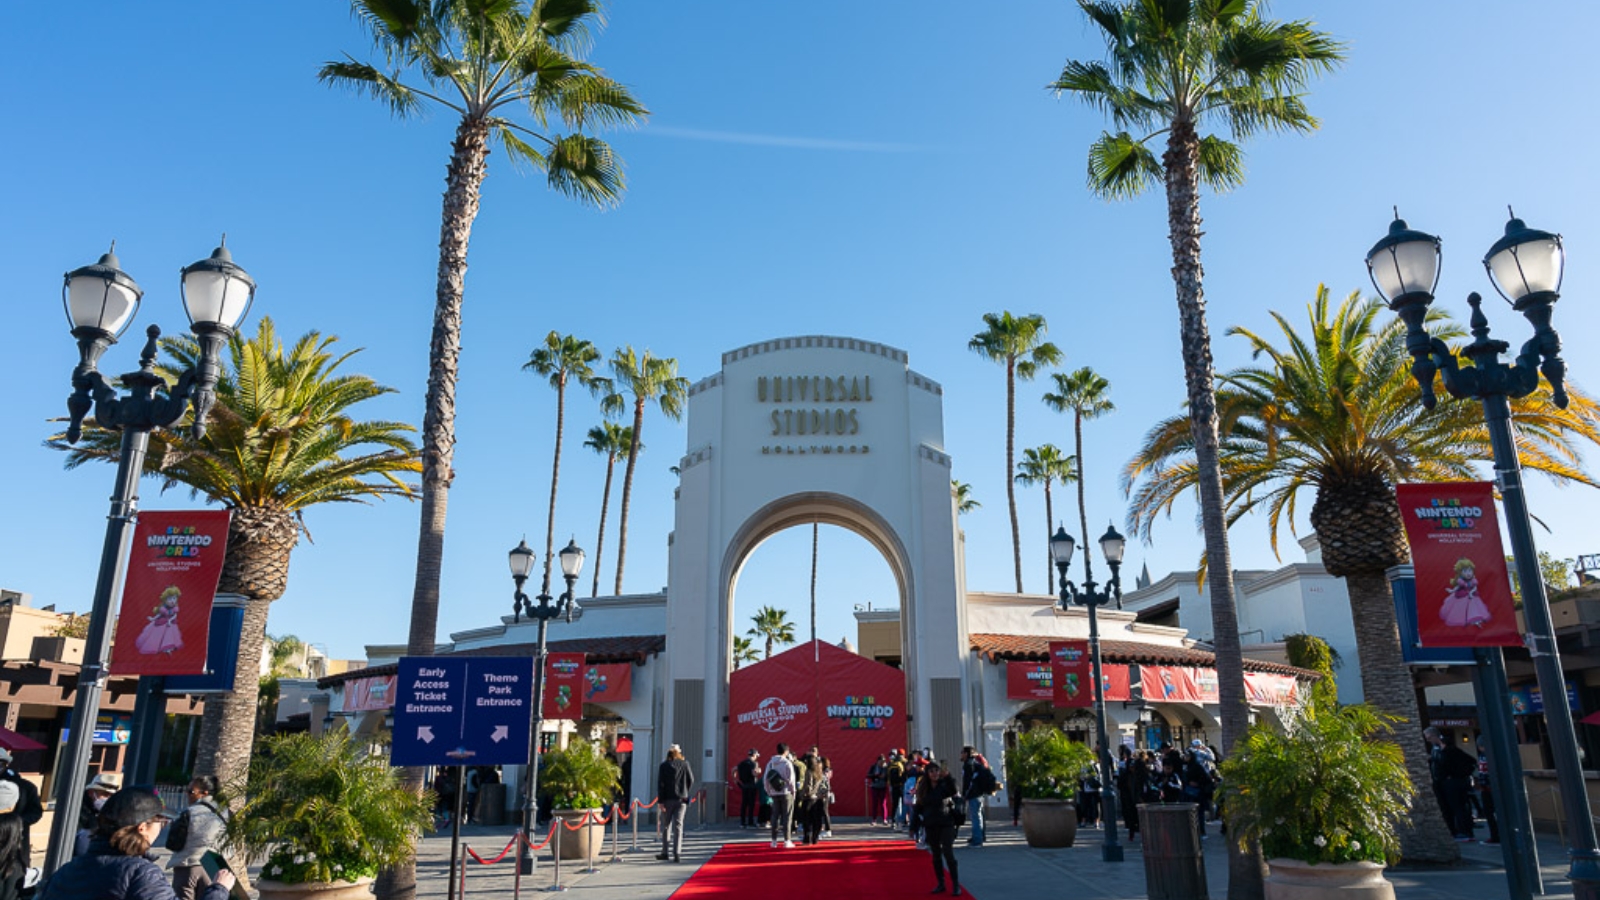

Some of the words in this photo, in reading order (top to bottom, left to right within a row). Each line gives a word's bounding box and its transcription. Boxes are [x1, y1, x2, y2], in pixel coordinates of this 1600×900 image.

[758, 375, 873, 402] UNIVERSAL
[771, 408, 859, 436] STUDIOS
[762, 445, 870, 454] HOLLYWOOD
[1431, 498, 1460, 506] SUER
[1414, 506, 1482, 518] NINTENDO
[1434, 518, 1475, 528] ORLD
[166, 526, 196, 534] SUER
[147, 534, 212, 546] NINTENDO
[156, 546, 200, 556] ORLD
[418, 668, 446, 678] Early
[484, 674, 519, 682] Theme
[413, 680, 449, 689] Access
[488, 686, 512, 694] Park
[414, 692, 447, 700] Ticket
[846, 696, 874, 704] SUER
[476, 698, 522, 706] Entrance
[406, 704, 453, 712] Entrance
[826, 705, 894, 717] NINTENDO
[737, 708, 776, 723] UNIVERSAL
[778, 704, 808, 716] STUDIOS
[842, 717, 883, 728] ORLD
